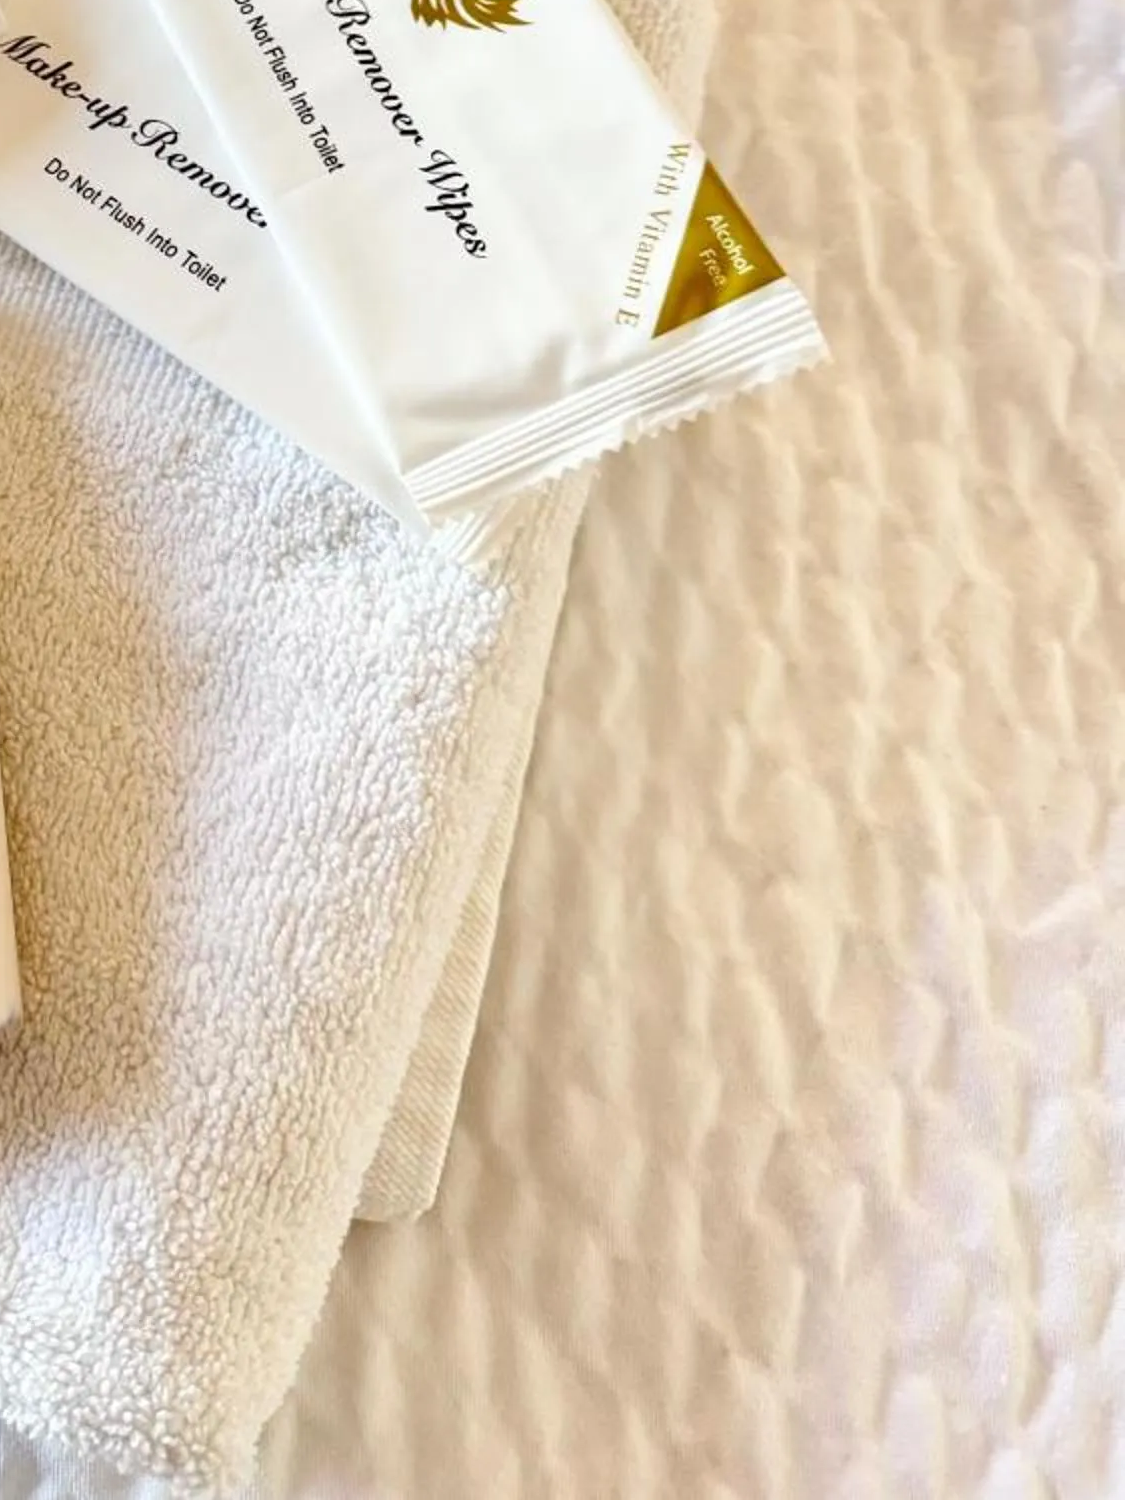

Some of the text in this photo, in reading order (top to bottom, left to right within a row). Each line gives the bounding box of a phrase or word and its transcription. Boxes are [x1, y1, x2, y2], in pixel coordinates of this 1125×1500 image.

[246, 16, 276, 48] Not
[263, 45, 297, 93] Flush
[288, 90, 316, 127] Into
[309, 124, 347, 174] Toilet
[43, 157, 228, 292] Do Not Flush Into Toilet
[419, 148, 488, 259] Wipes
[615, 142, 692, 328] With Vitamin E
[704, 213, 755, 276] Alcohol
[698, 247, 727, 288] Free
